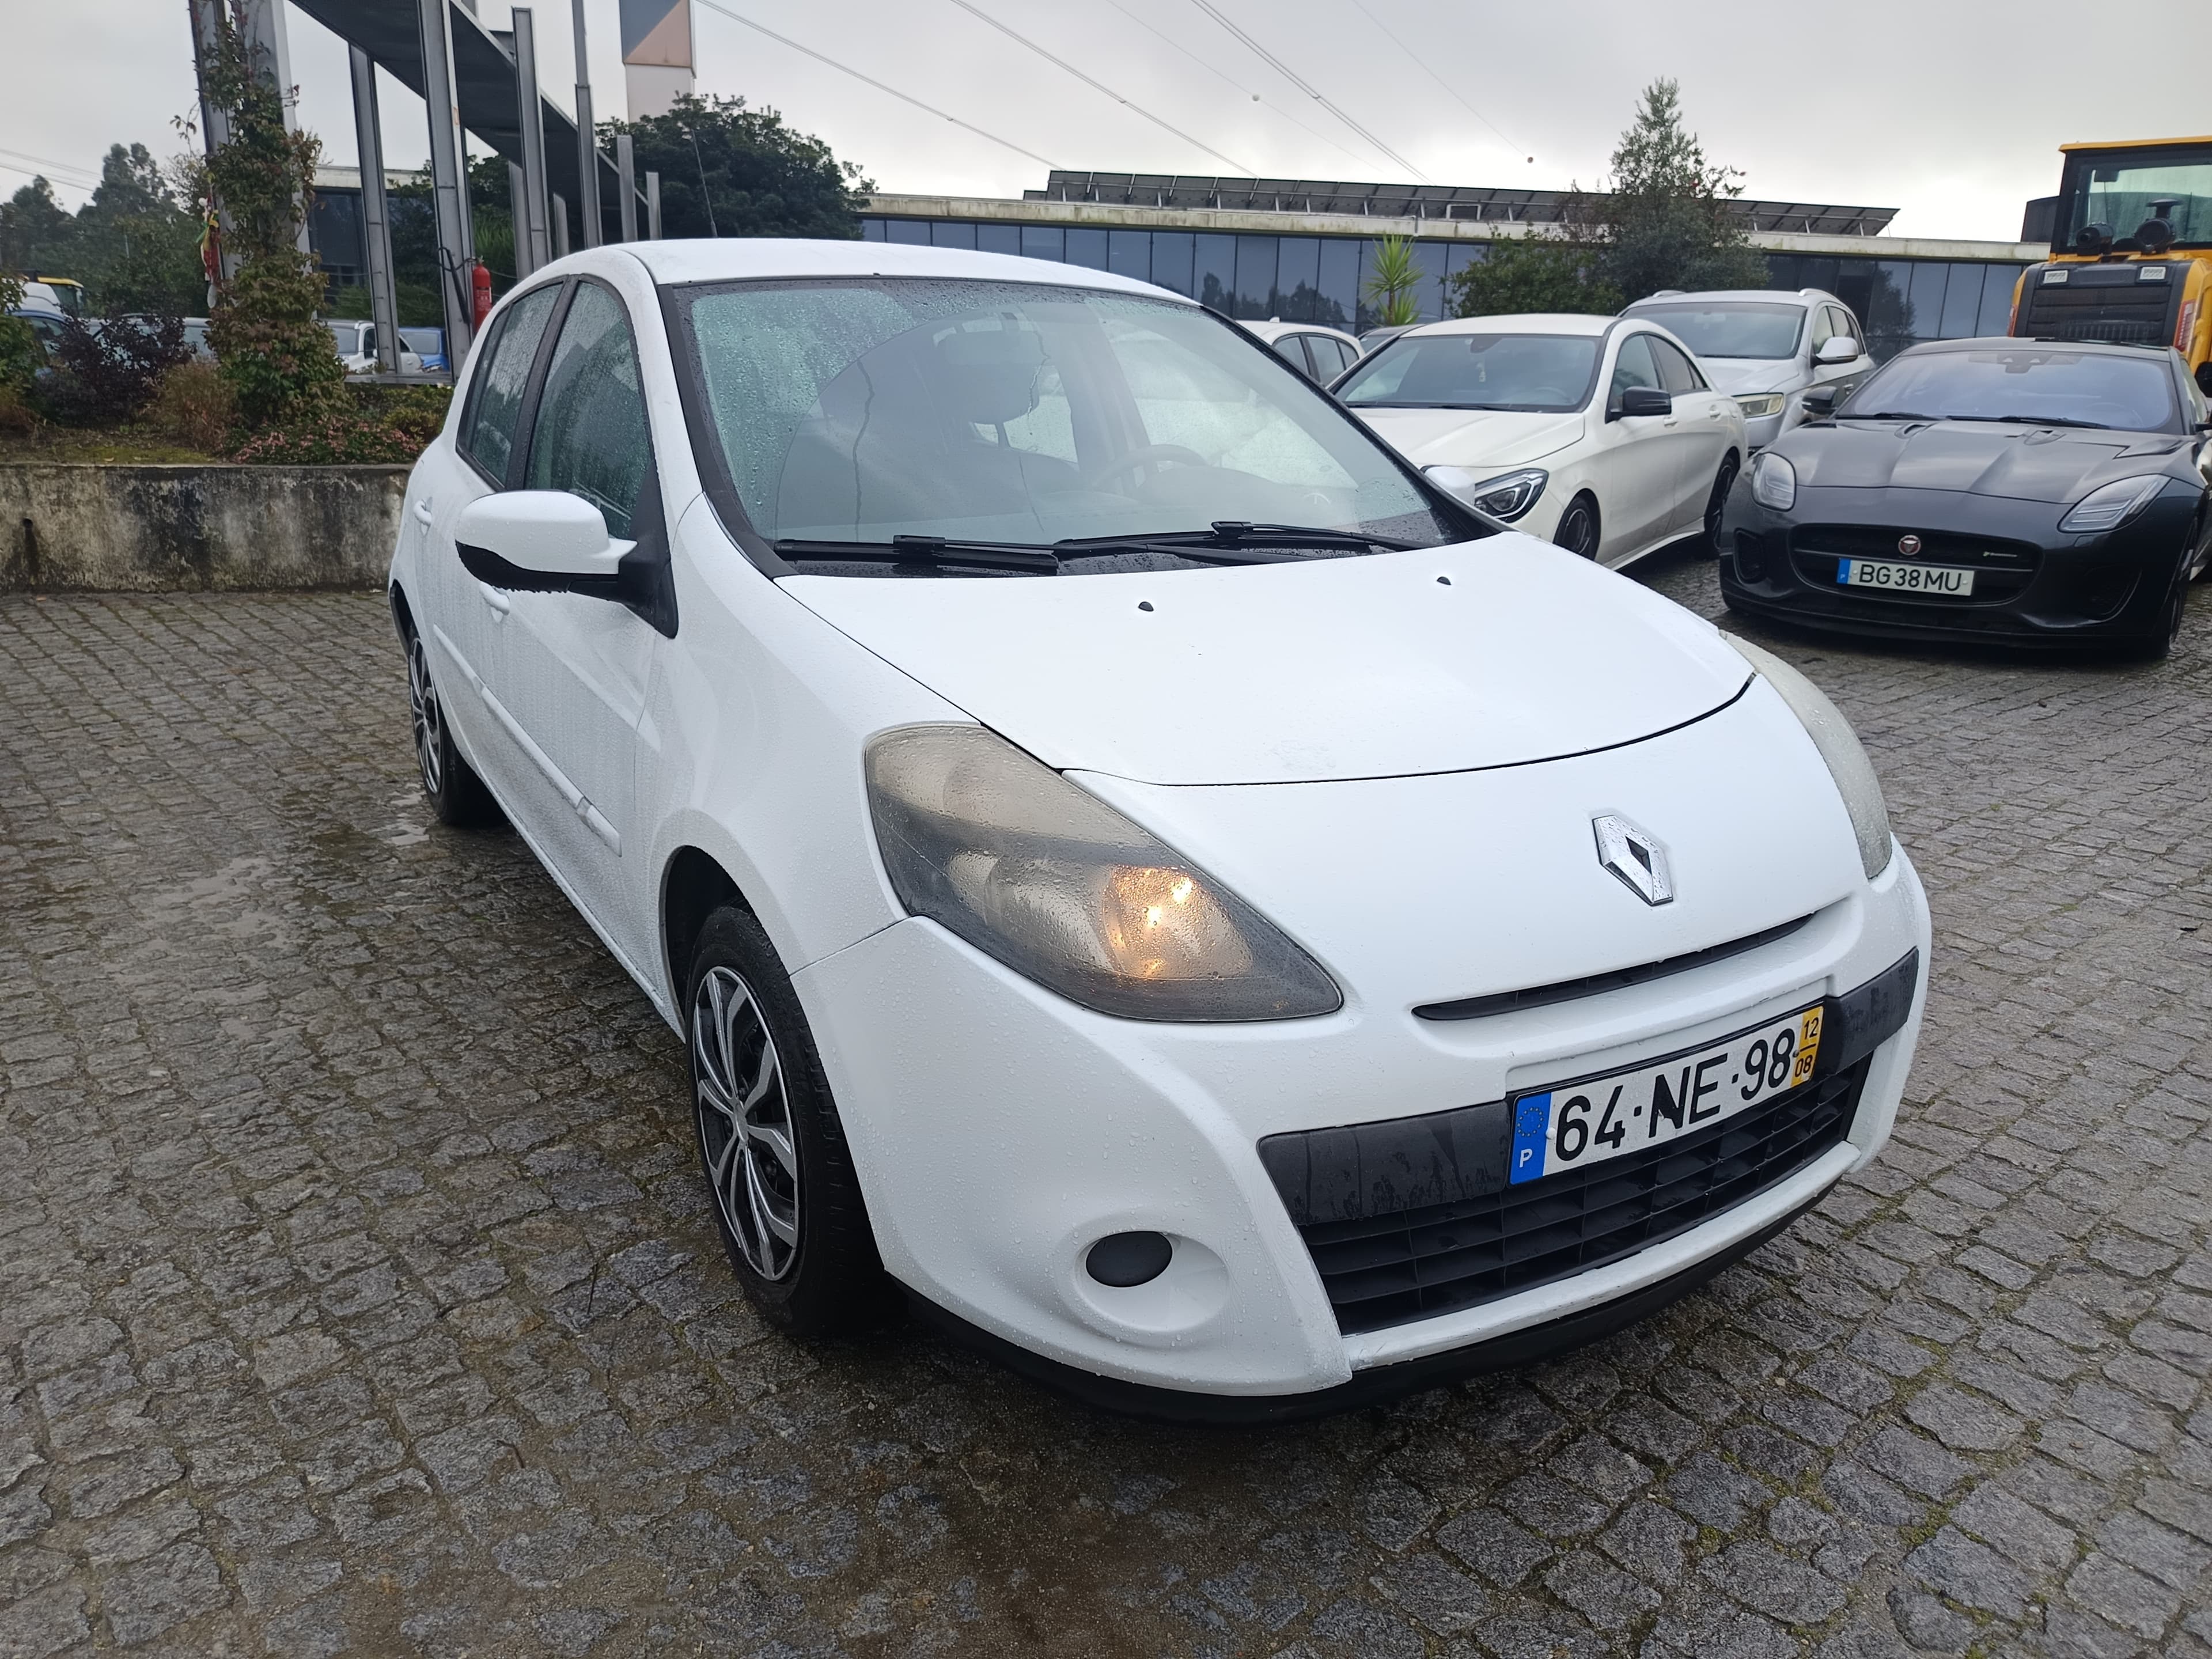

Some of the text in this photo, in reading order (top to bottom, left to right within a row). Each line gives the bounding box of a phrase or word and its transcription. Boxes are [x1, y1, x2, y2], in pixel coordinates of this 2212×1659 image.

[1804, 1017, 1819, 1040] 12
[1794, 1054, 1813, 1078] 08
[1519, 1148, 1533, 1168] P
